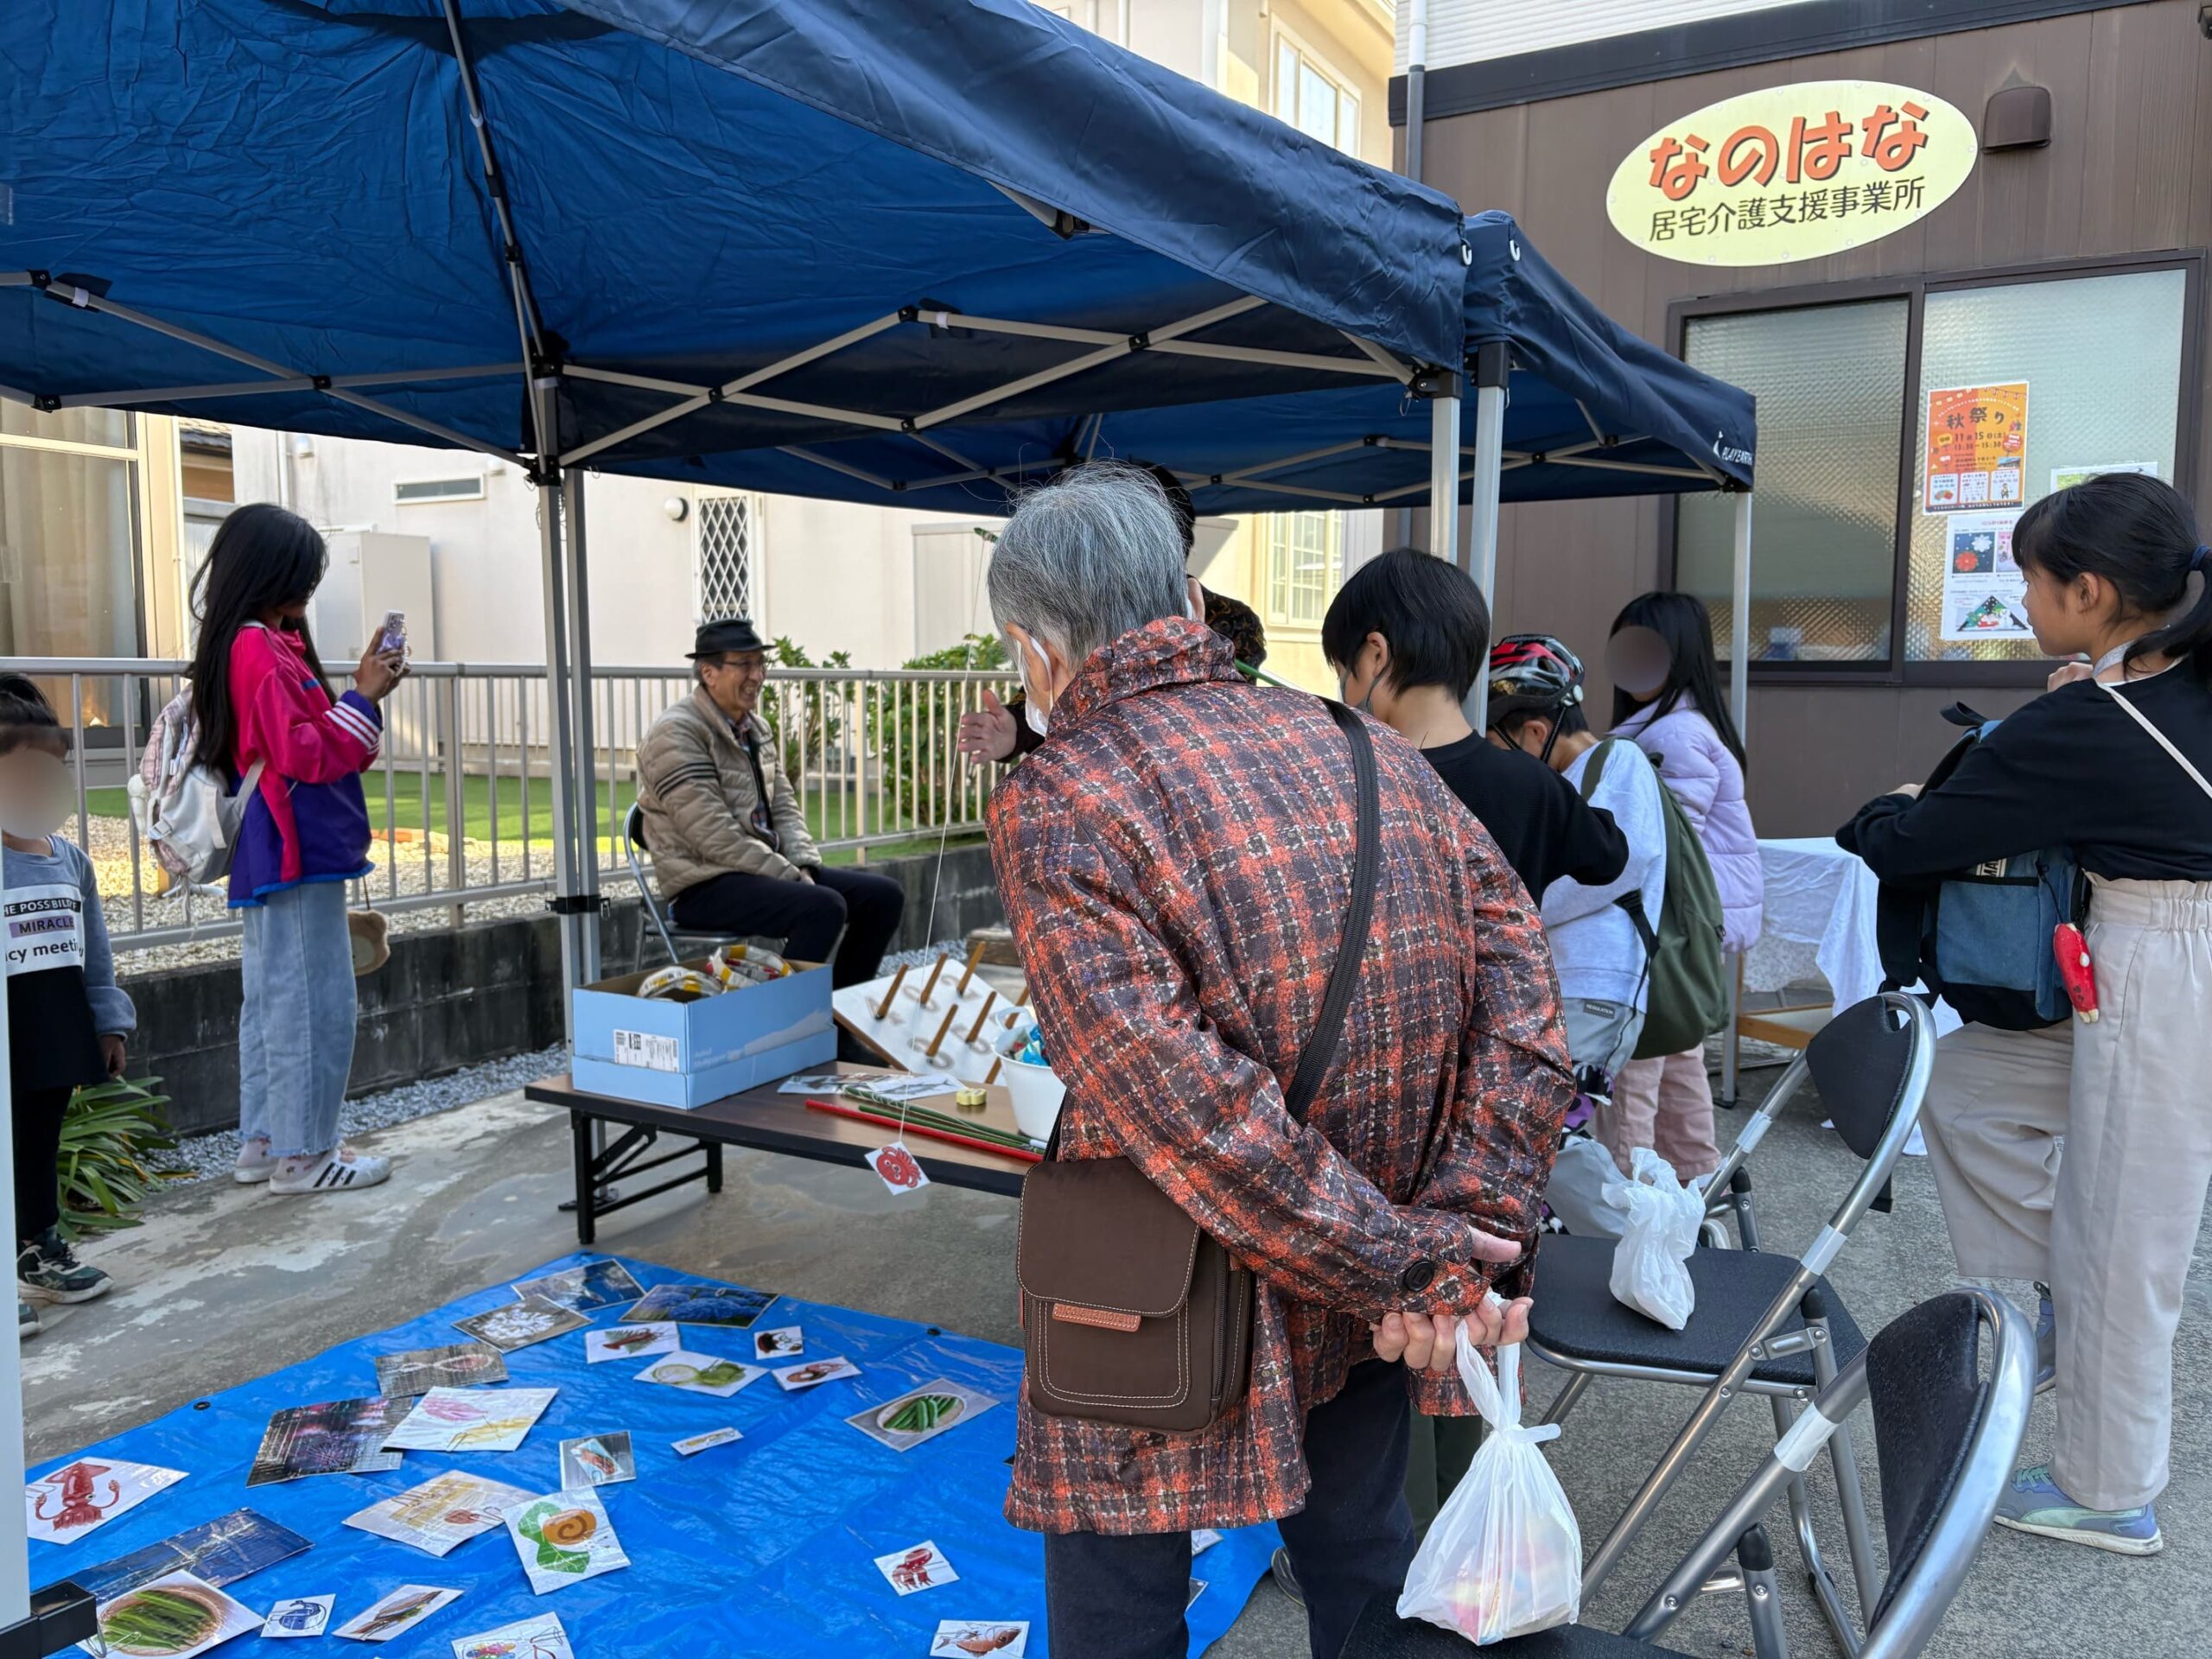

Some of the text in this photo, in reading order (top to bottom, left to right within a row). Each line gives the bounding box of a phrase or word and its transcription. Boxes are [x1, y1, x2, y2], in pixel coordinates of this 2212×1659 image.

[1649, 101, 1929, 200] なのはな
[1649, 176, 1925, 241] 居宅介護支援事業所
[1947, 407, 2005, 429] 秋祭り
[19, 918, 74, 934] MIRACLE
